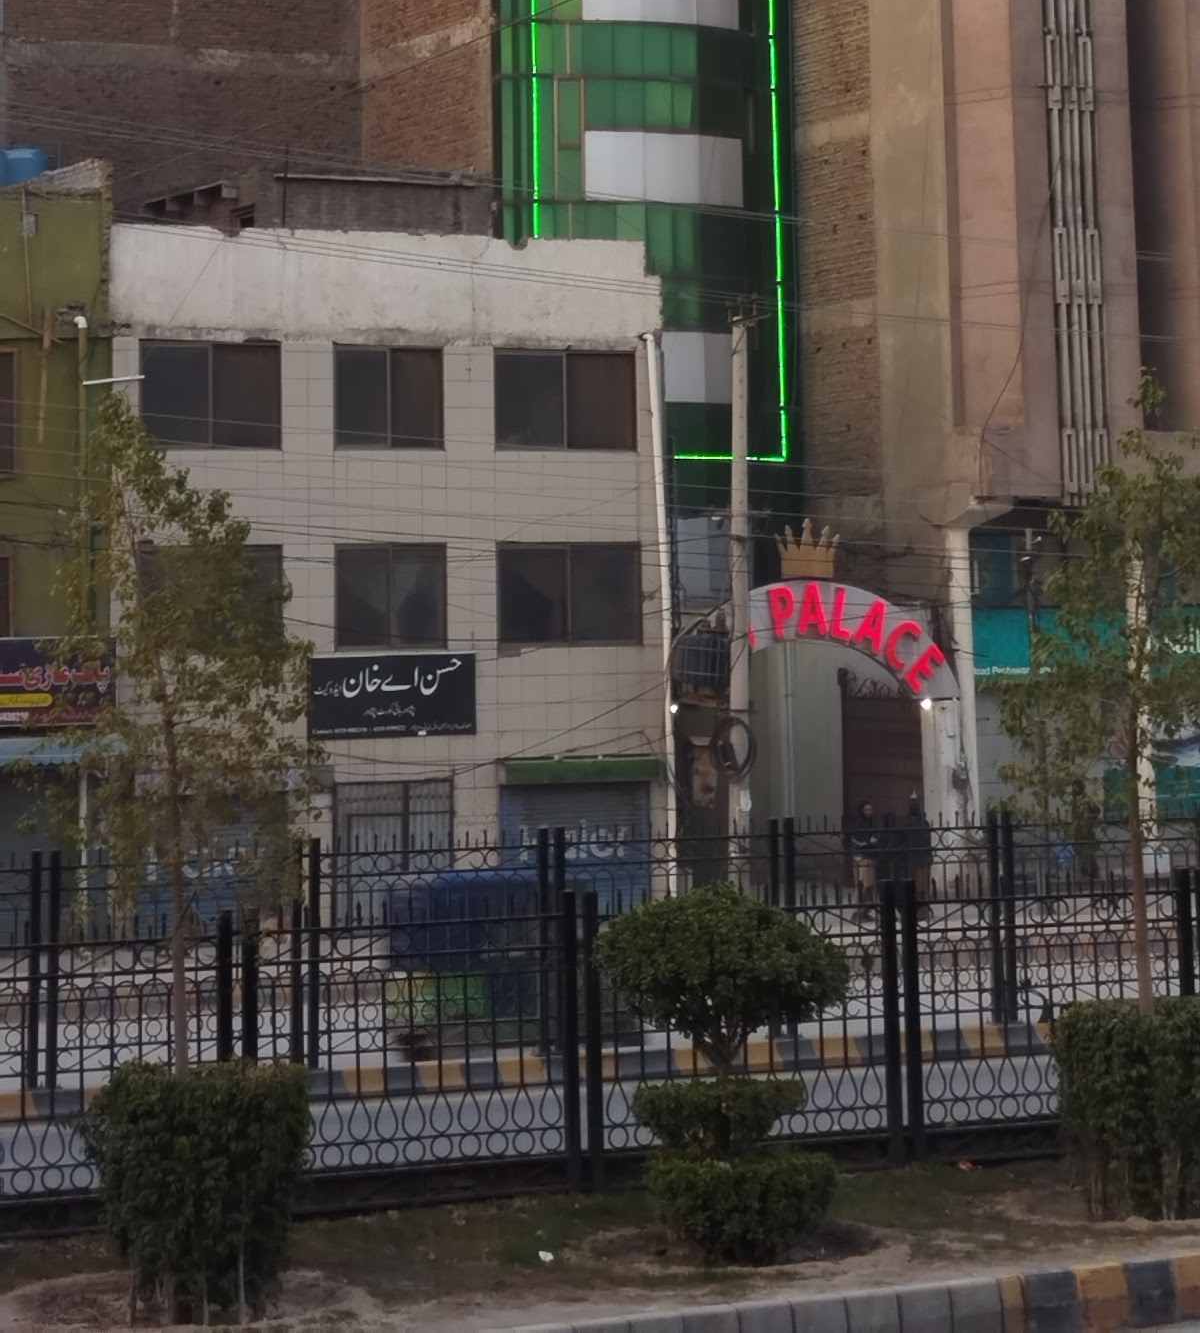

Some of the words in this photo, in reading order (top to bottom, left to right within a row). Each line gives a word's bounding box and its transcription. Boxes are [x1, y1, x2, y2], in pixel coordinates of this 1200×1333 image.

[767, 581, 946, 694] PALACE
[342, 664, 382, 699] خان
[380, 666, 420, 692] اے
[419, 657, 462, 695] حسن
